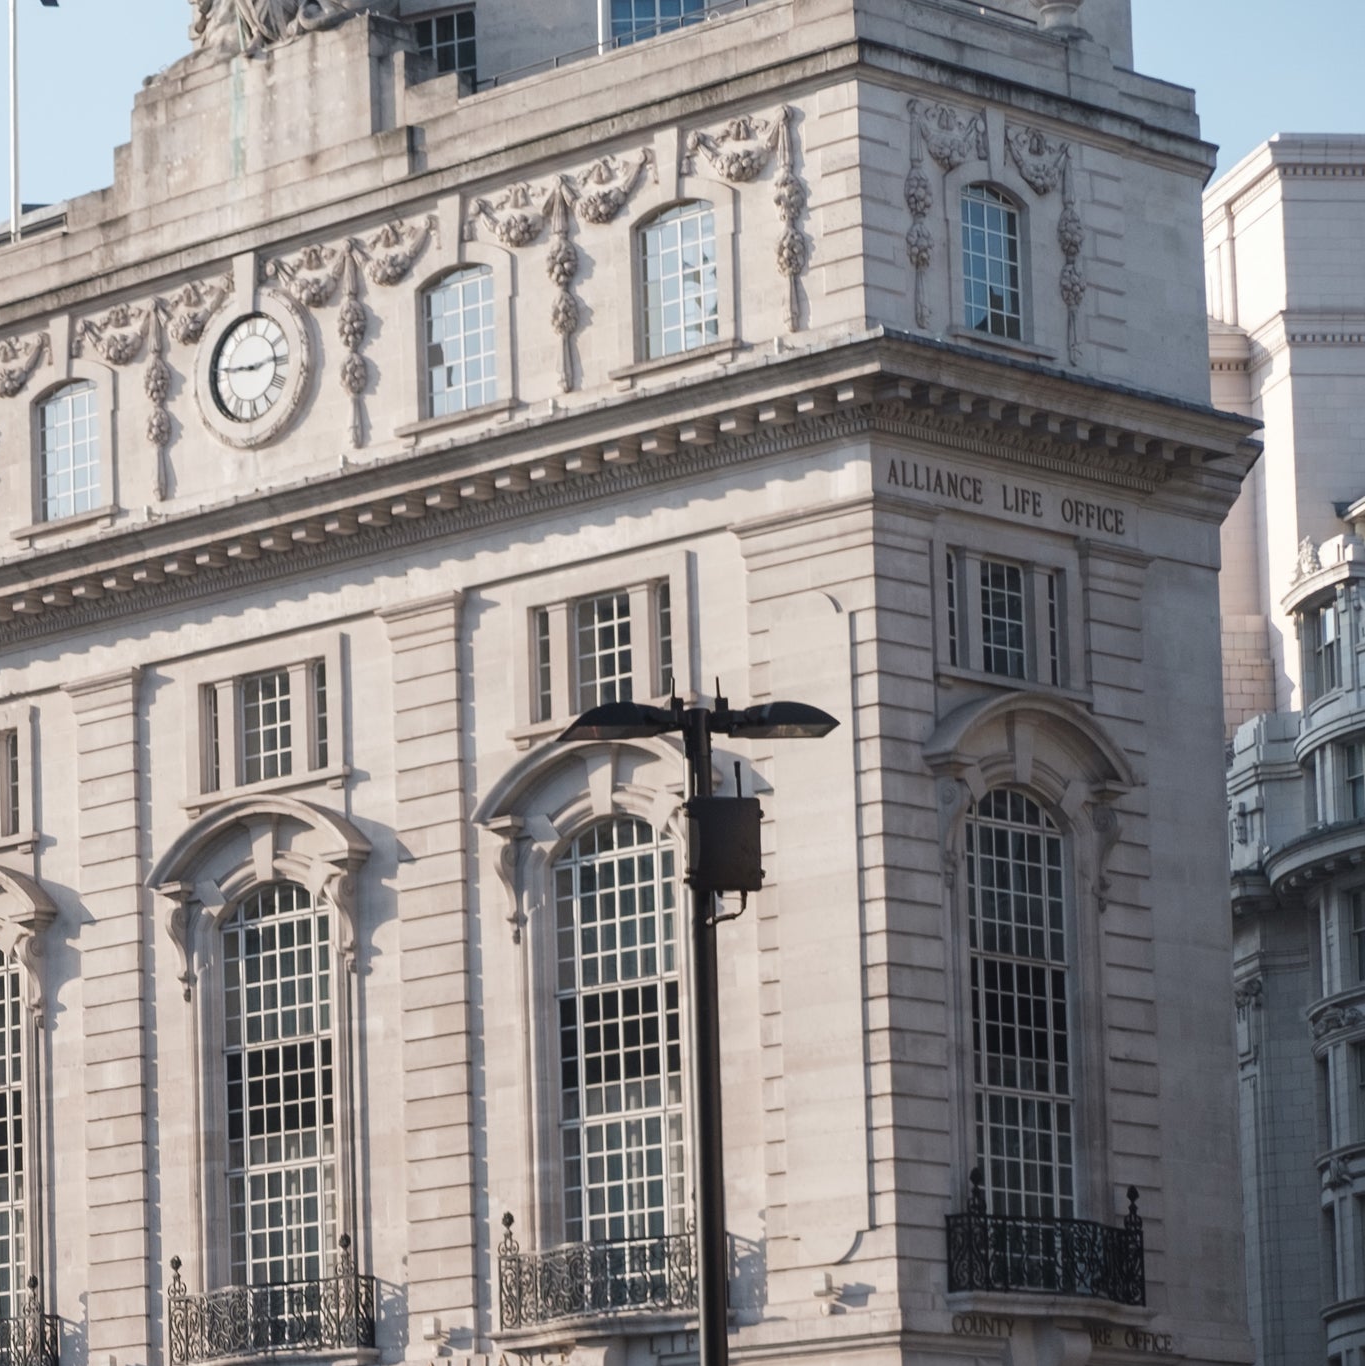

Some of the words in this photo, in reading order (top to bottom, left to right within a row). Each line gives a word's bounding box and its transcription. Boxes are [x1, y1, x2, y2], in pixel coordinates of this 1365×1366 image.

[887, 459, 983, 505] ALLIANCE
[1002, 484, 1043, 518] LIFE
[1061, 498, 1125, 536] OFFICE
[650, 1333, 699, 1356] LIF
[952, 1315, 1014, 1337] COUNTY
[1089, 1328, 1113, 1346] IRE
[1124, 1331, 1173, 1352] OFFICE
